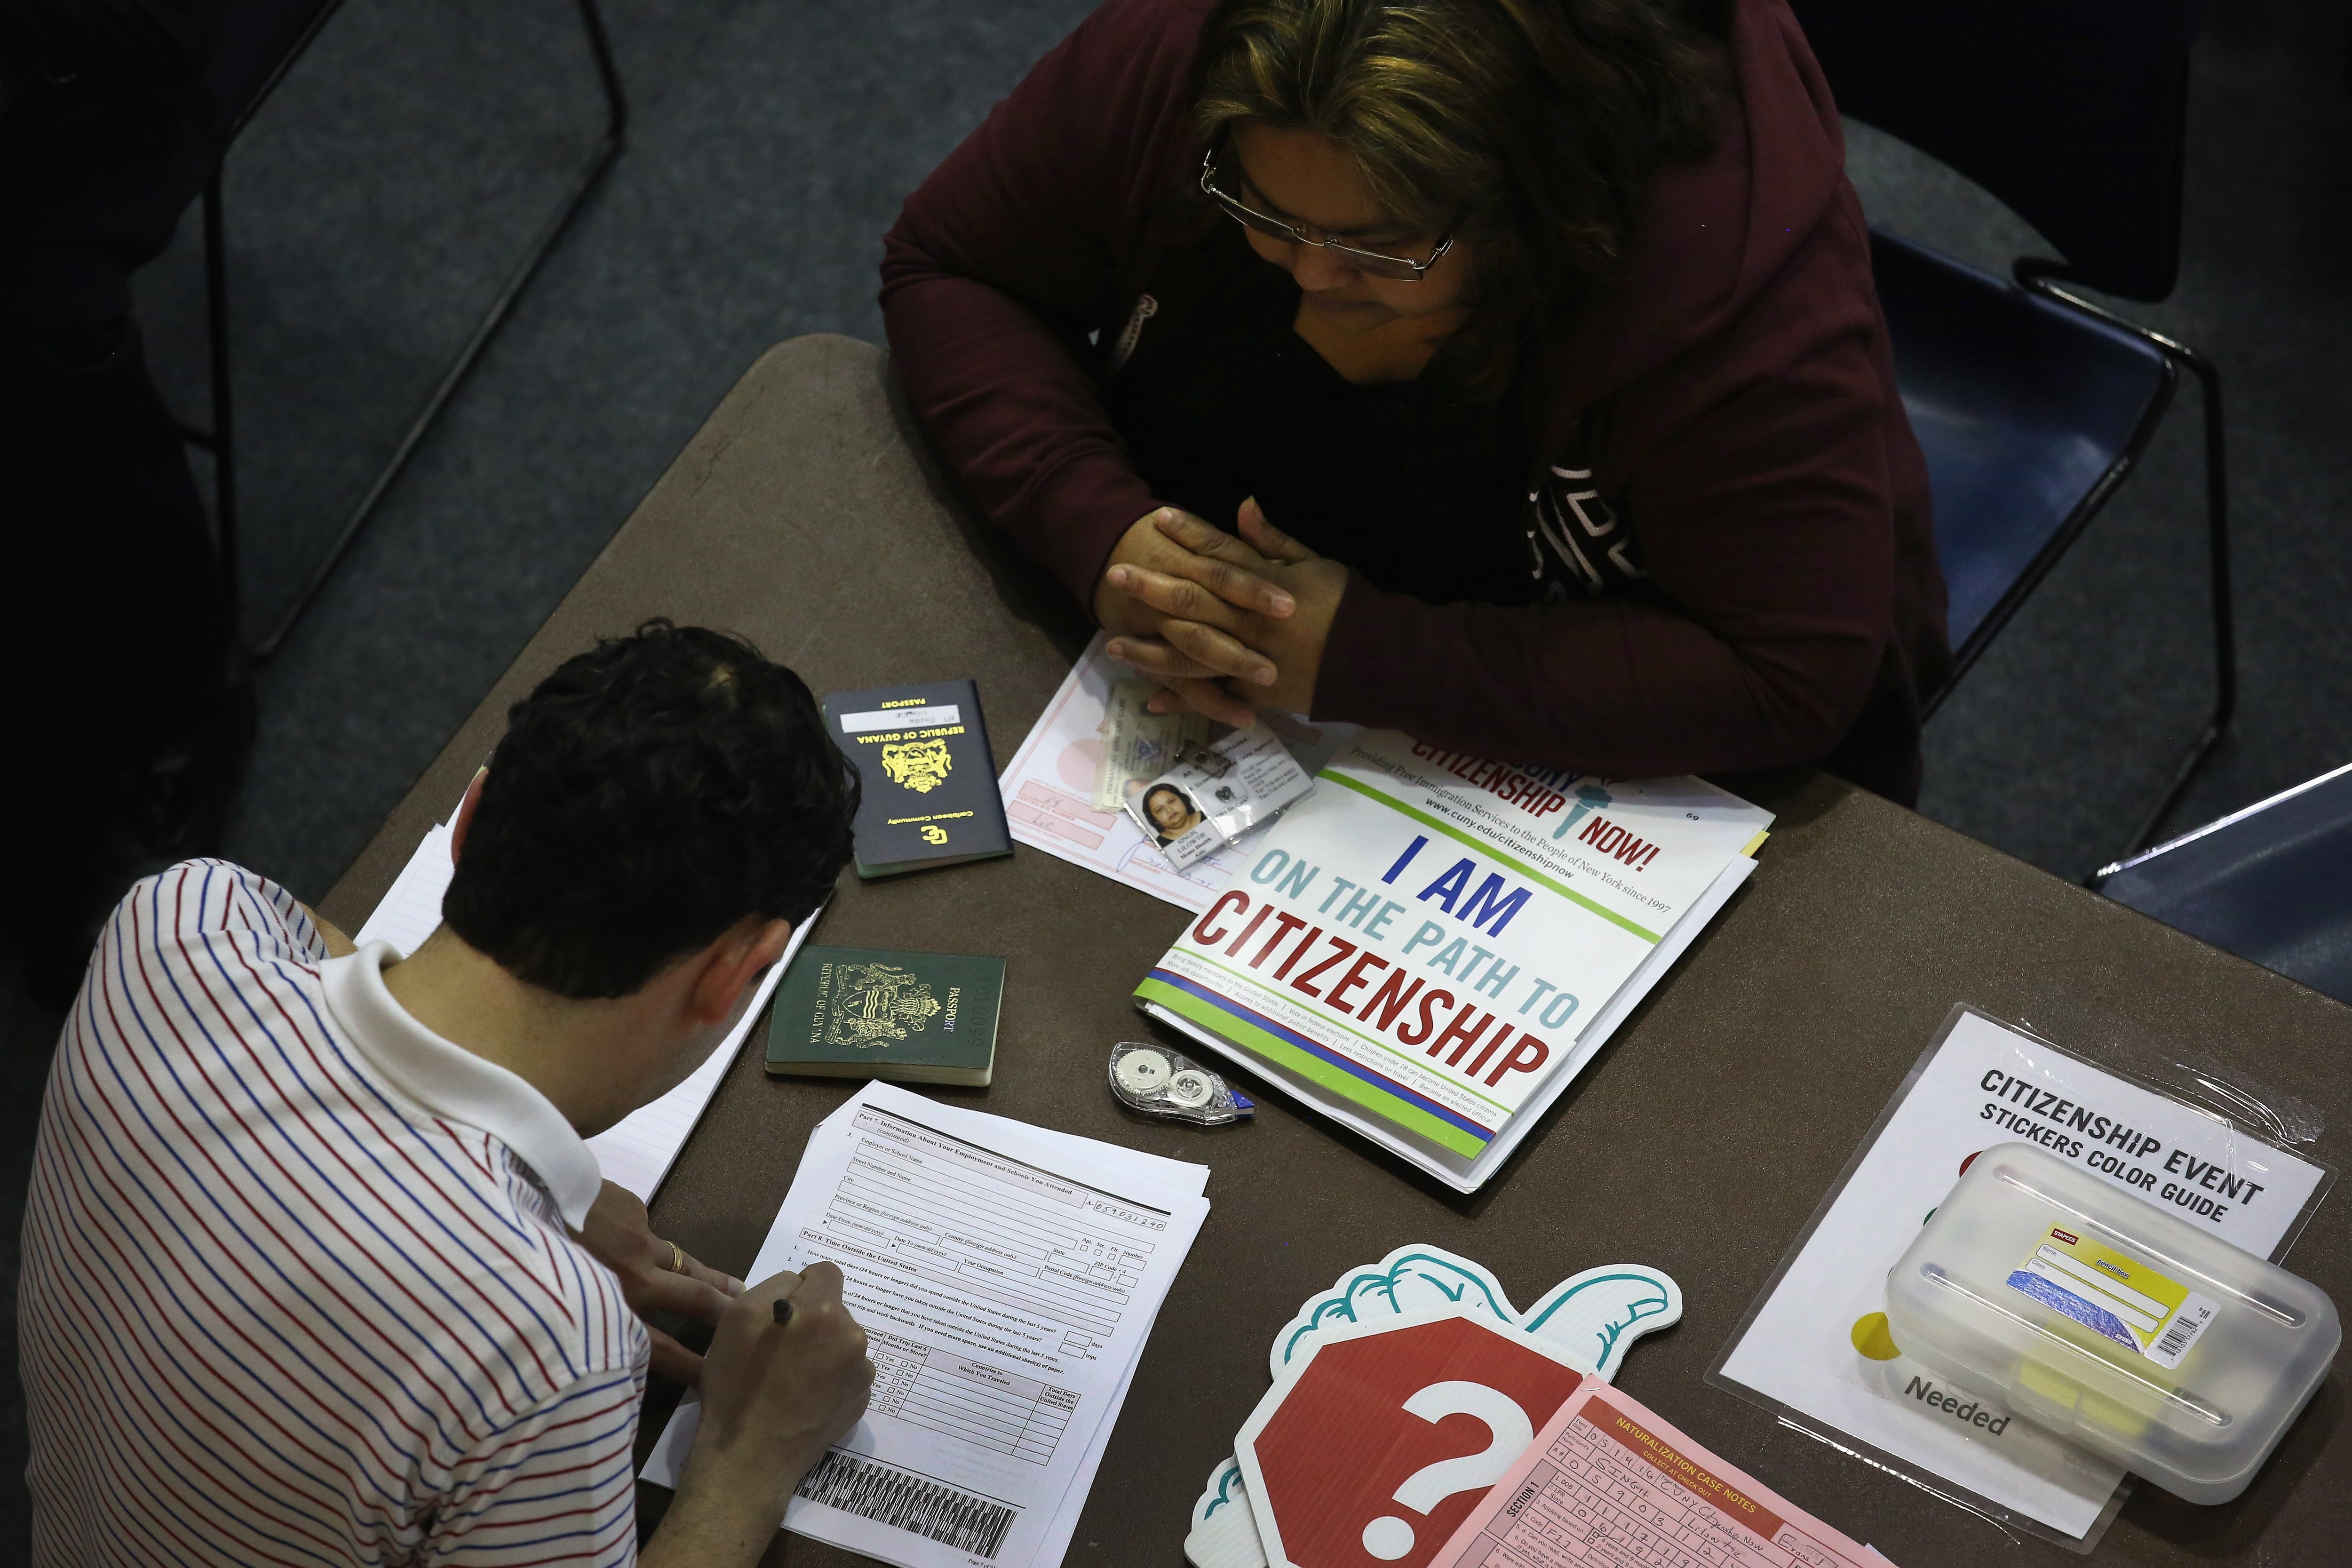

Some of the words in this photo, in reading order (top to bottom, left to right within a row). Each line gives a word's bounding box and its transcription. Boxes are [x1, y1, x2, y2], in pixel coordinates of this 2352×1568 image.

[881, 699, 925, 709] PASSPORT
[857, 733, 901, 744] GUYANA
[919, 726, 965, 738] REPUBLIC
[888, 816, 931, 824] Community
[1351, 747, 1396, 774] Providing
[1395, 764, 1416, 783] Free
[1415, 775, 1472, 810] Immigration
[1471, 804, 1510, 828] Services
[1510, 825, 1520, 834] to
[1521, 831, 1536, 843] the
[1536, 838, 1567, 859] People
[1567, 856, 1581, 867] of
[1578, 861, 1600, 876] New
[1601, 872, 1622, 889] York
[1622, 887, 1646, 902] since
[1647, 898, 1671, 913] 1997
[1426, 798, 1573, 878] www.cuny.edu/citizenshipnow
[1578, 816, 1660, 872] NOW!
[1382, 835, 1429, 884] I
[1416, 858, 1533, 938] AM
[1251, 849, 1321, 900] ON
[1318, 876, 1406, 941] THE
[1401, 920, 1520, 999] PATH
[1518, 978, 1579, 1029] TO
[818, 964, 832, 997] REPUBLIC
[1192, 891, 1549, 1087] CITIZENSHIP
[816, 1000, 826, 1010] OF
[944, 987, 960, 1032] PASSPORT
[810, 1012, 824, 1043] GUYNA
[1172, 954, 1186, 963] Bring
[1187, 960, 1203, 970] family
[1203, 968, 1227, 981] members
[1244, 987, 1262, 997] United
[1262, 995, 1278, 1006] States
[1289, 1009, 1300, 1017] Vote
[1308, 1018, 1327, 1029] federal
[1327, 1028, 1350, 1042] elections
[1361, 1044, 1383, 1058] Children
[1383, 1057, 1399, 1066] under
[1419, 1074, 1439, 1086] become
[1441, 1084, 1459, 1096] United
[1459, 1094, 1476, 1105] States
[1477, 1104, 1497, 1116] citizens
[1234, 992, 1253, 1003] Access
[1261, 1006, 1288, 1020] additional
[1288, 1019, 1306, 1029] public
[1307, 1027, 1329, 1041] benefits
[1340, 1044, 1352, 1052] Less
[1353, 1051, 1383, 1068] restrictions
[1393, 1071, 1409, 1081] travel
[1419, 1083, 1441, 1097] Become
[1451, 1100, 1471, 1112] elected
[1472, 1111, 1492, 1123] official
[877, 1129, 909, 1143] (continued)
[1981, 1070, 2161, 1158] CITIZENSHIP
[2163, 1149, 2264, 1205] EVENT
[861, 1138, 883, 1149] Employer
[891, 1149, 908, 1158] School
[881, 1121, 916, 1138] Information
[918, 1136, 936, 1145] About
[939, 1143, 954, 1152] Your
[955, 1149, 993, 1166] Employment
[1007, 1169, 1029, 1179] Schools
[1044, 1183, 1072, 1194] Attended
[867, 1162, 886, 1172] Number
[1980, 1104, 2083, 1157] STICKERS
[2087, 1151, 2157, 1192] COLOR
[2161, 1183, 2228, 1222] GUIDE
[2053, 1230, 2076, 1243] STAPLES
[842, 1244, 865, 1255] Outside
[878, 1256, 898, 1266] United
[899, 1263, 916, 1272] States
[1123, 1250, 1143, 1259] Number
[2042, 1246, 2057, 1256] Name:
[977, 1264, 1003, 1275] Occupation
[2032, 1260, 2046, 1269] Class:
[2097, 1259, 2119, 1272] pencil
[2116, 1268, 2130, 1279] box
[972, 1361, 996, 1373] Countries
[988, 1375, 1010, 1385] Traveled
[1905, 1376, 2010, 1436] Needed
[1575, 1419, 1587, 1428] Event
[1562, 1436, 1573, 1446] Name
[1564, 1432, 1589, 1450] Participant's
[1616, 1417, 1696, 1475] NATURALIZATION
[1698, 1473, 1724, 1491] CASE
[1724, 1489, 1756, 1512] NOTES
[1644, 1451, 1669, 1469] COLLECT
[1678, 1474, 1698, 1489] CHECK
[1699, 1488, 1712, 1497] OUT
[1561, 1480, 1573, 1489] DOB
[1596, 1458, 1648, 1497] SINGH
[1507, 1487, 1534, 1517] SECTION
[1549, 1494, 1564, 1504] Since
[1554, 1488, 1565, 1497] LPR
[1531, 1517, 1543, 1527] Code
[1542, 1504, 1562, 1520] Applying
[1562, 1517, 1577, 1528] based
